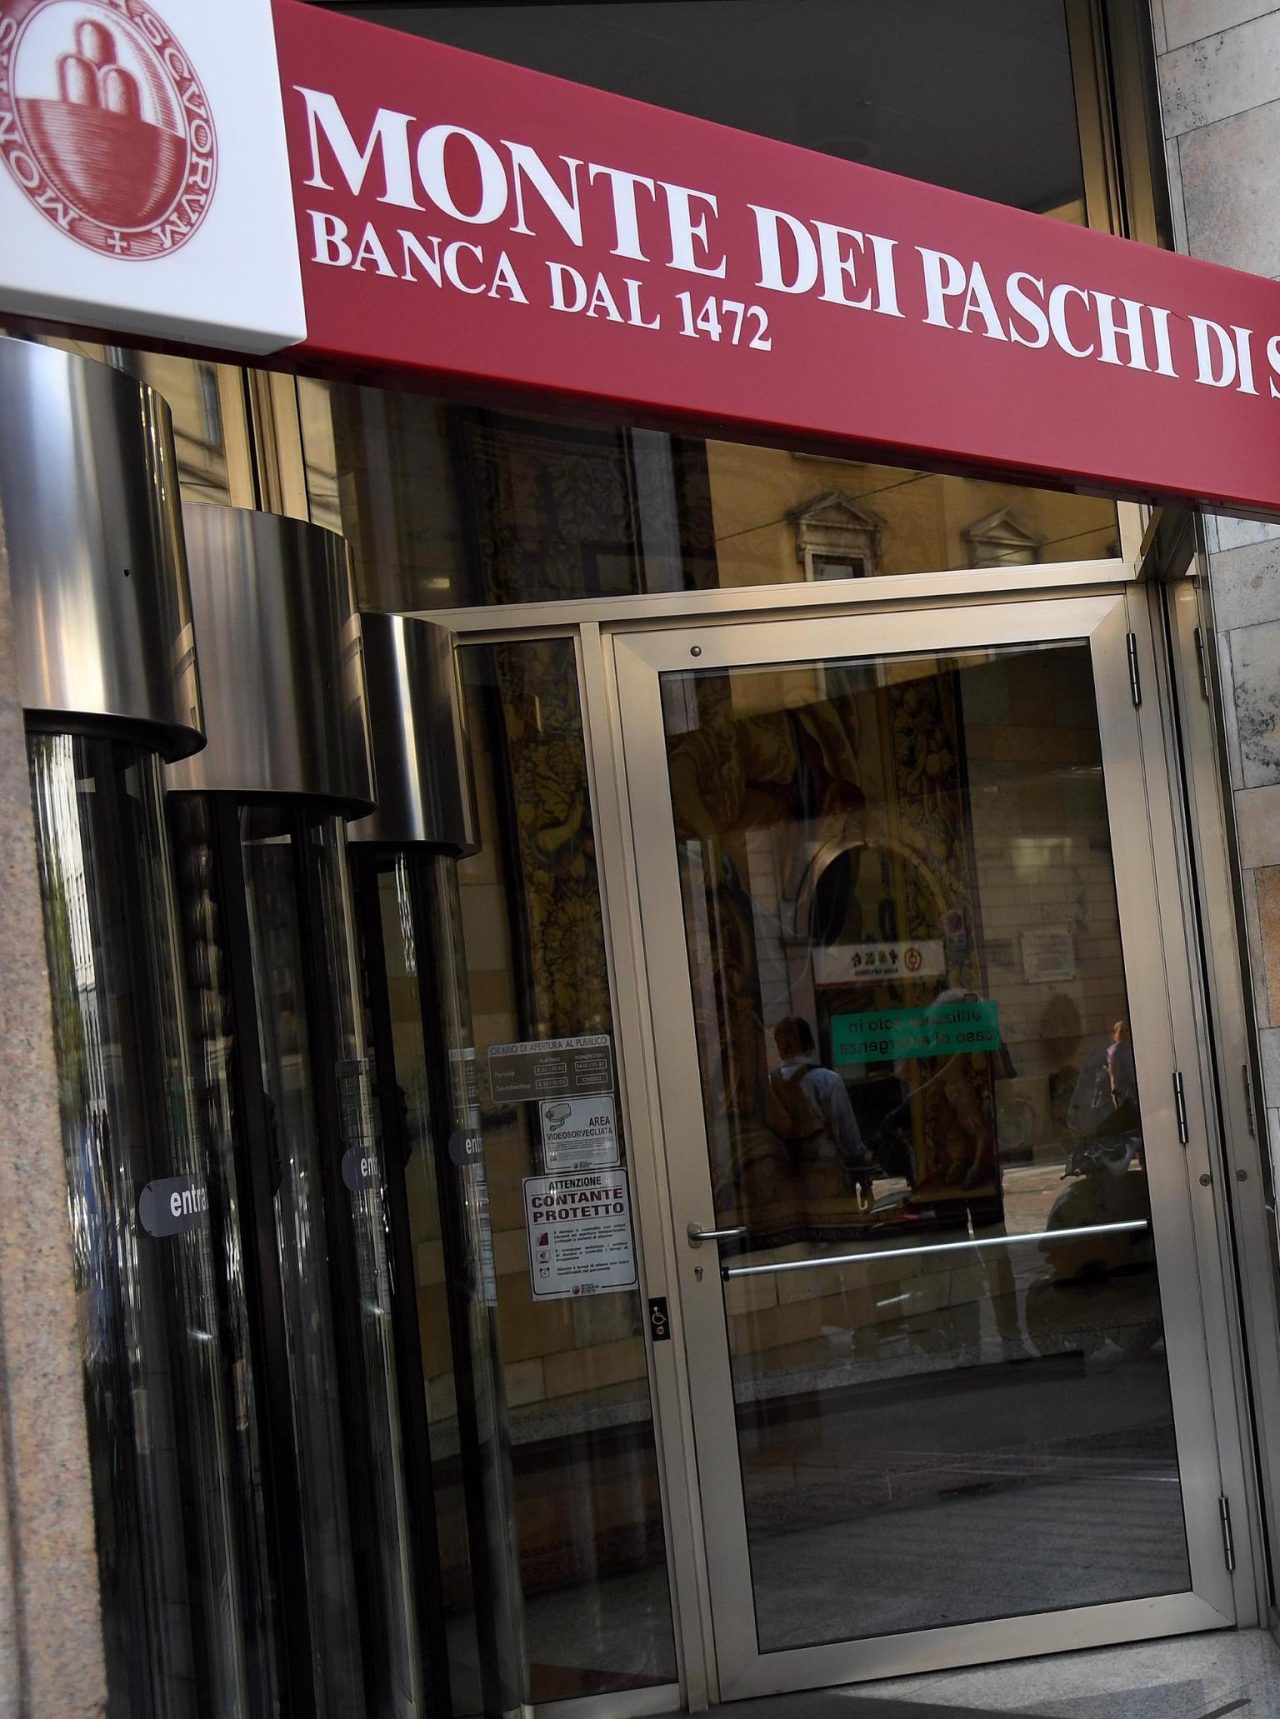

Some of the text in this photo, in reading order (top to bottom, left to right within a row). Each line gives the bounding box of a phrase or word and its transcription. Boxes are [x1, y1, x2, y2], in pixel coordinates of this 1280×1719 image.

[293, 85, 727, 279] MONTE
[747, 203, 905, 318] DEI
[915, 246, 1179, 378] PASCHI
[1188, 315, 1260, 396] DI
[306, 209, 772, 352] BANCA DAL 1472
[490, 1036, 607, 1055] ORARIO DI APERTURA AL PUBBLICO
[589, 1116, 611, 1127] AREA
[546, 1128, 613, 1141] VIDEOSORVEGLIATA
[549, 1176, 602, 1190] ATTENZIONE
[531, 1188, 624, 1208] CONTANTE
[533, 1202, 625, 1222] PROTETTO
